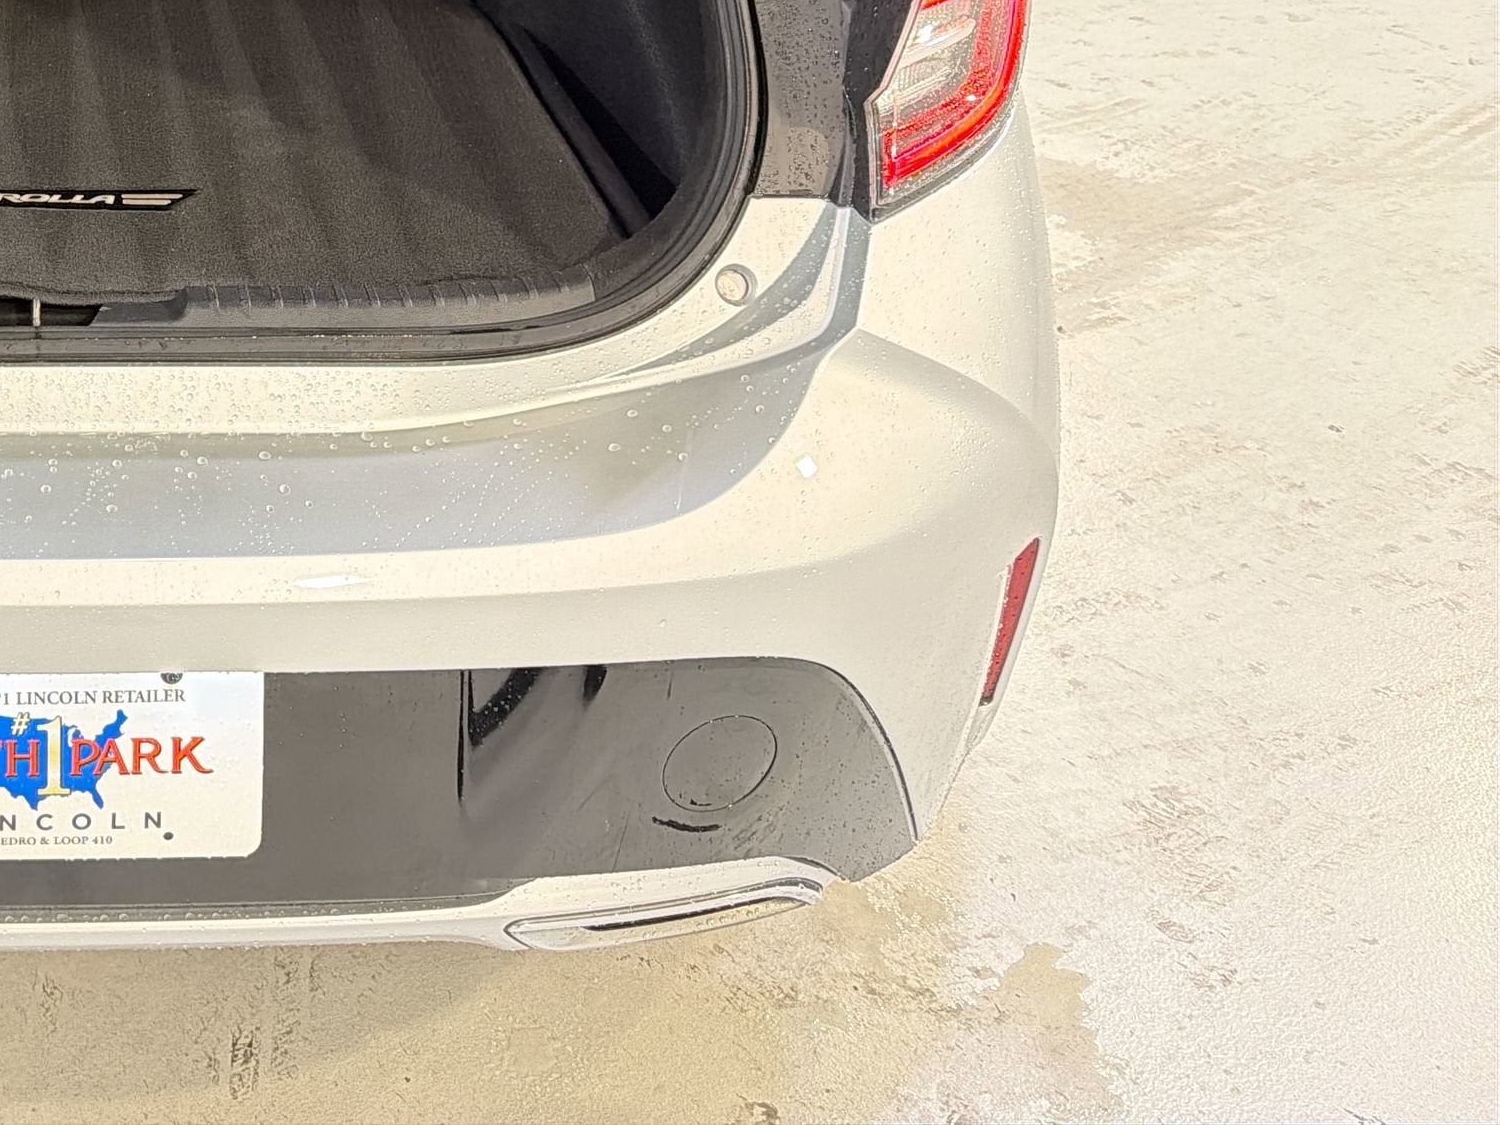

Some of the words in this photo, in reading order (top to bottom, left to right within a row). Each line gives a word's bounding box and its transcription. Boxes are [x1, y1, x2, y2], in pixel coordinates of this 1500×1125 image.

[16, 690, 98, 706] LINCOLN
[102, 688, 187, 704] RETAILER
[70, 736, 214, 778] PARK
[40, 836, 51, 846] &
[54, 835, 90, 846] LOOP
[92, 835, 114, 845] 410
